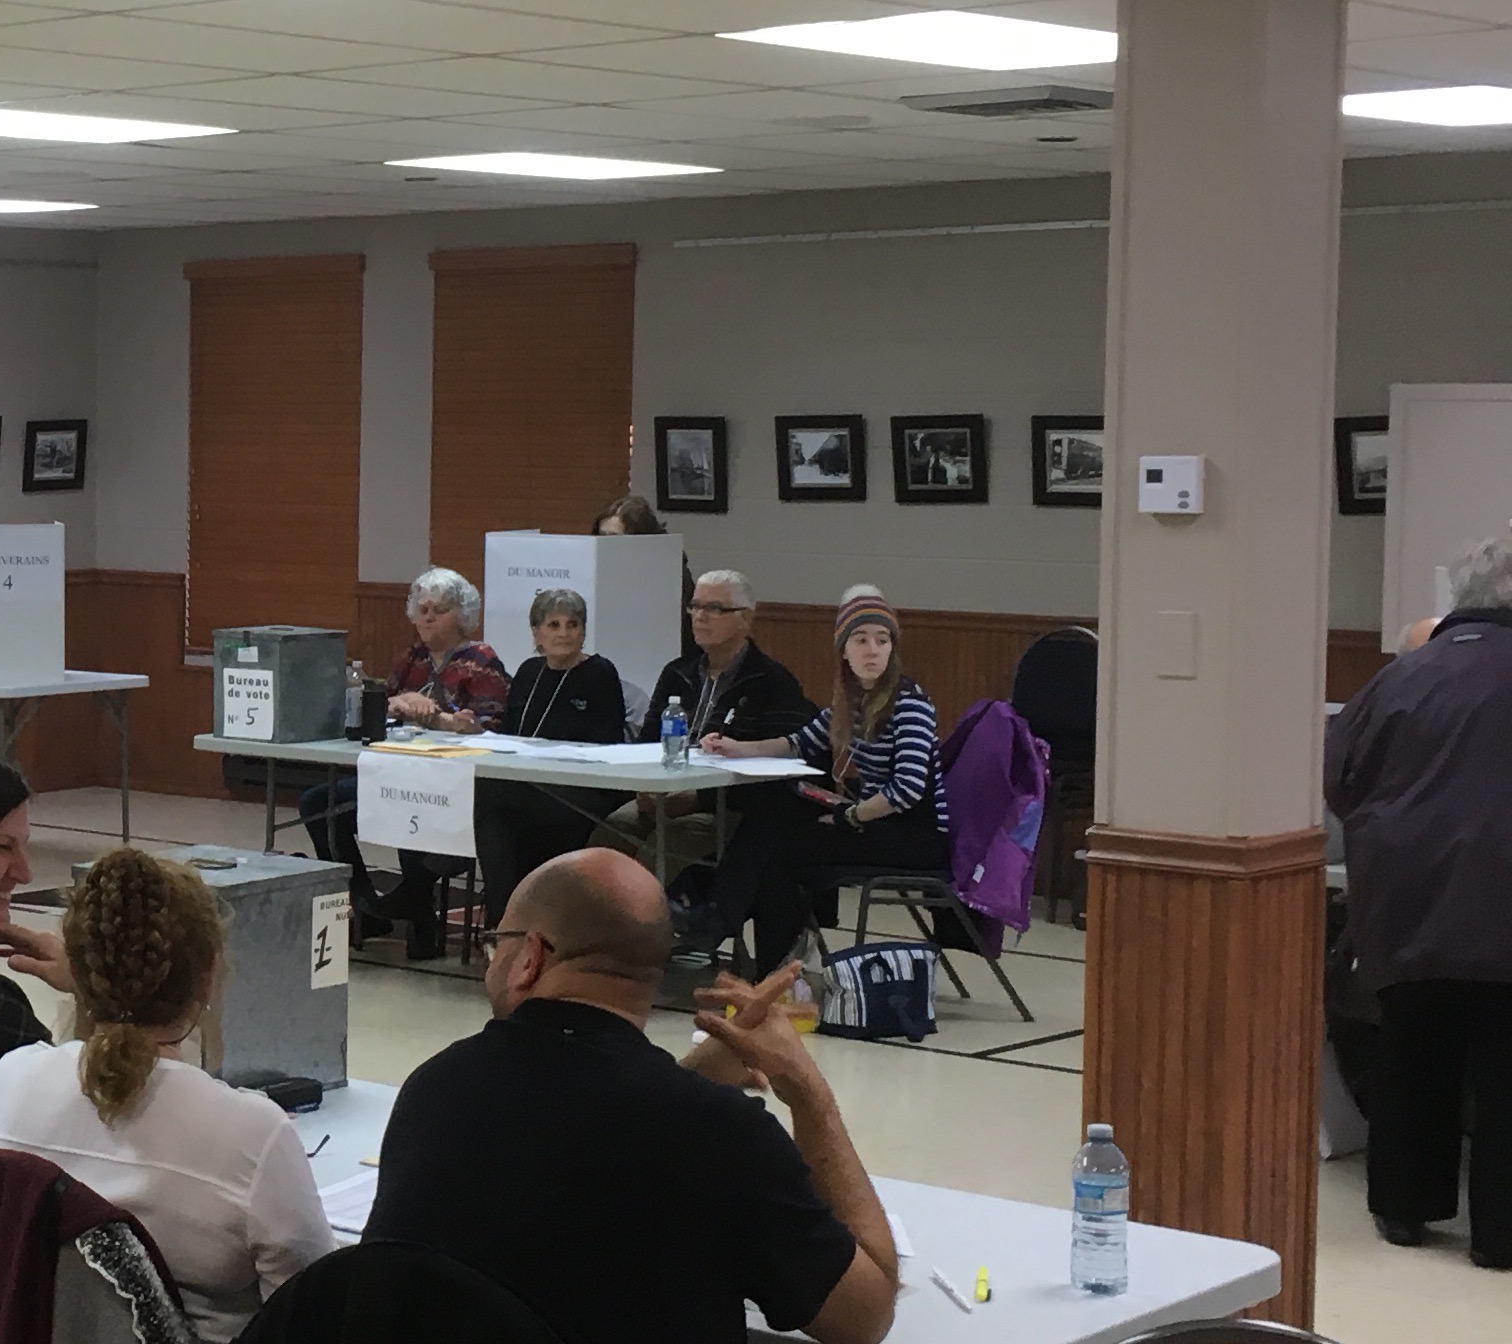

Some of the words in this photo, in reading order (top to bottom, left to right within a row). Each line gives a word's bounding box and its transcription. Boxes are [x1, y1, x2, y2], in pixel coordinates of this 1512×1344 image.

[508, 567, 522, 577] DU
[527, 567, 570, 579] MANOIR
[3, 575, 13, 590] 4
[228, 675, 269, 687] Bureau
[228, 688, 240, 698] de
[246, 690, 270, 701] vote
[245, 707, 258, 725] 5
[380, 785, 397, 799] DU
[400, 790, 450, 807] MANOIR
[409, 815, 419, 834] 5
